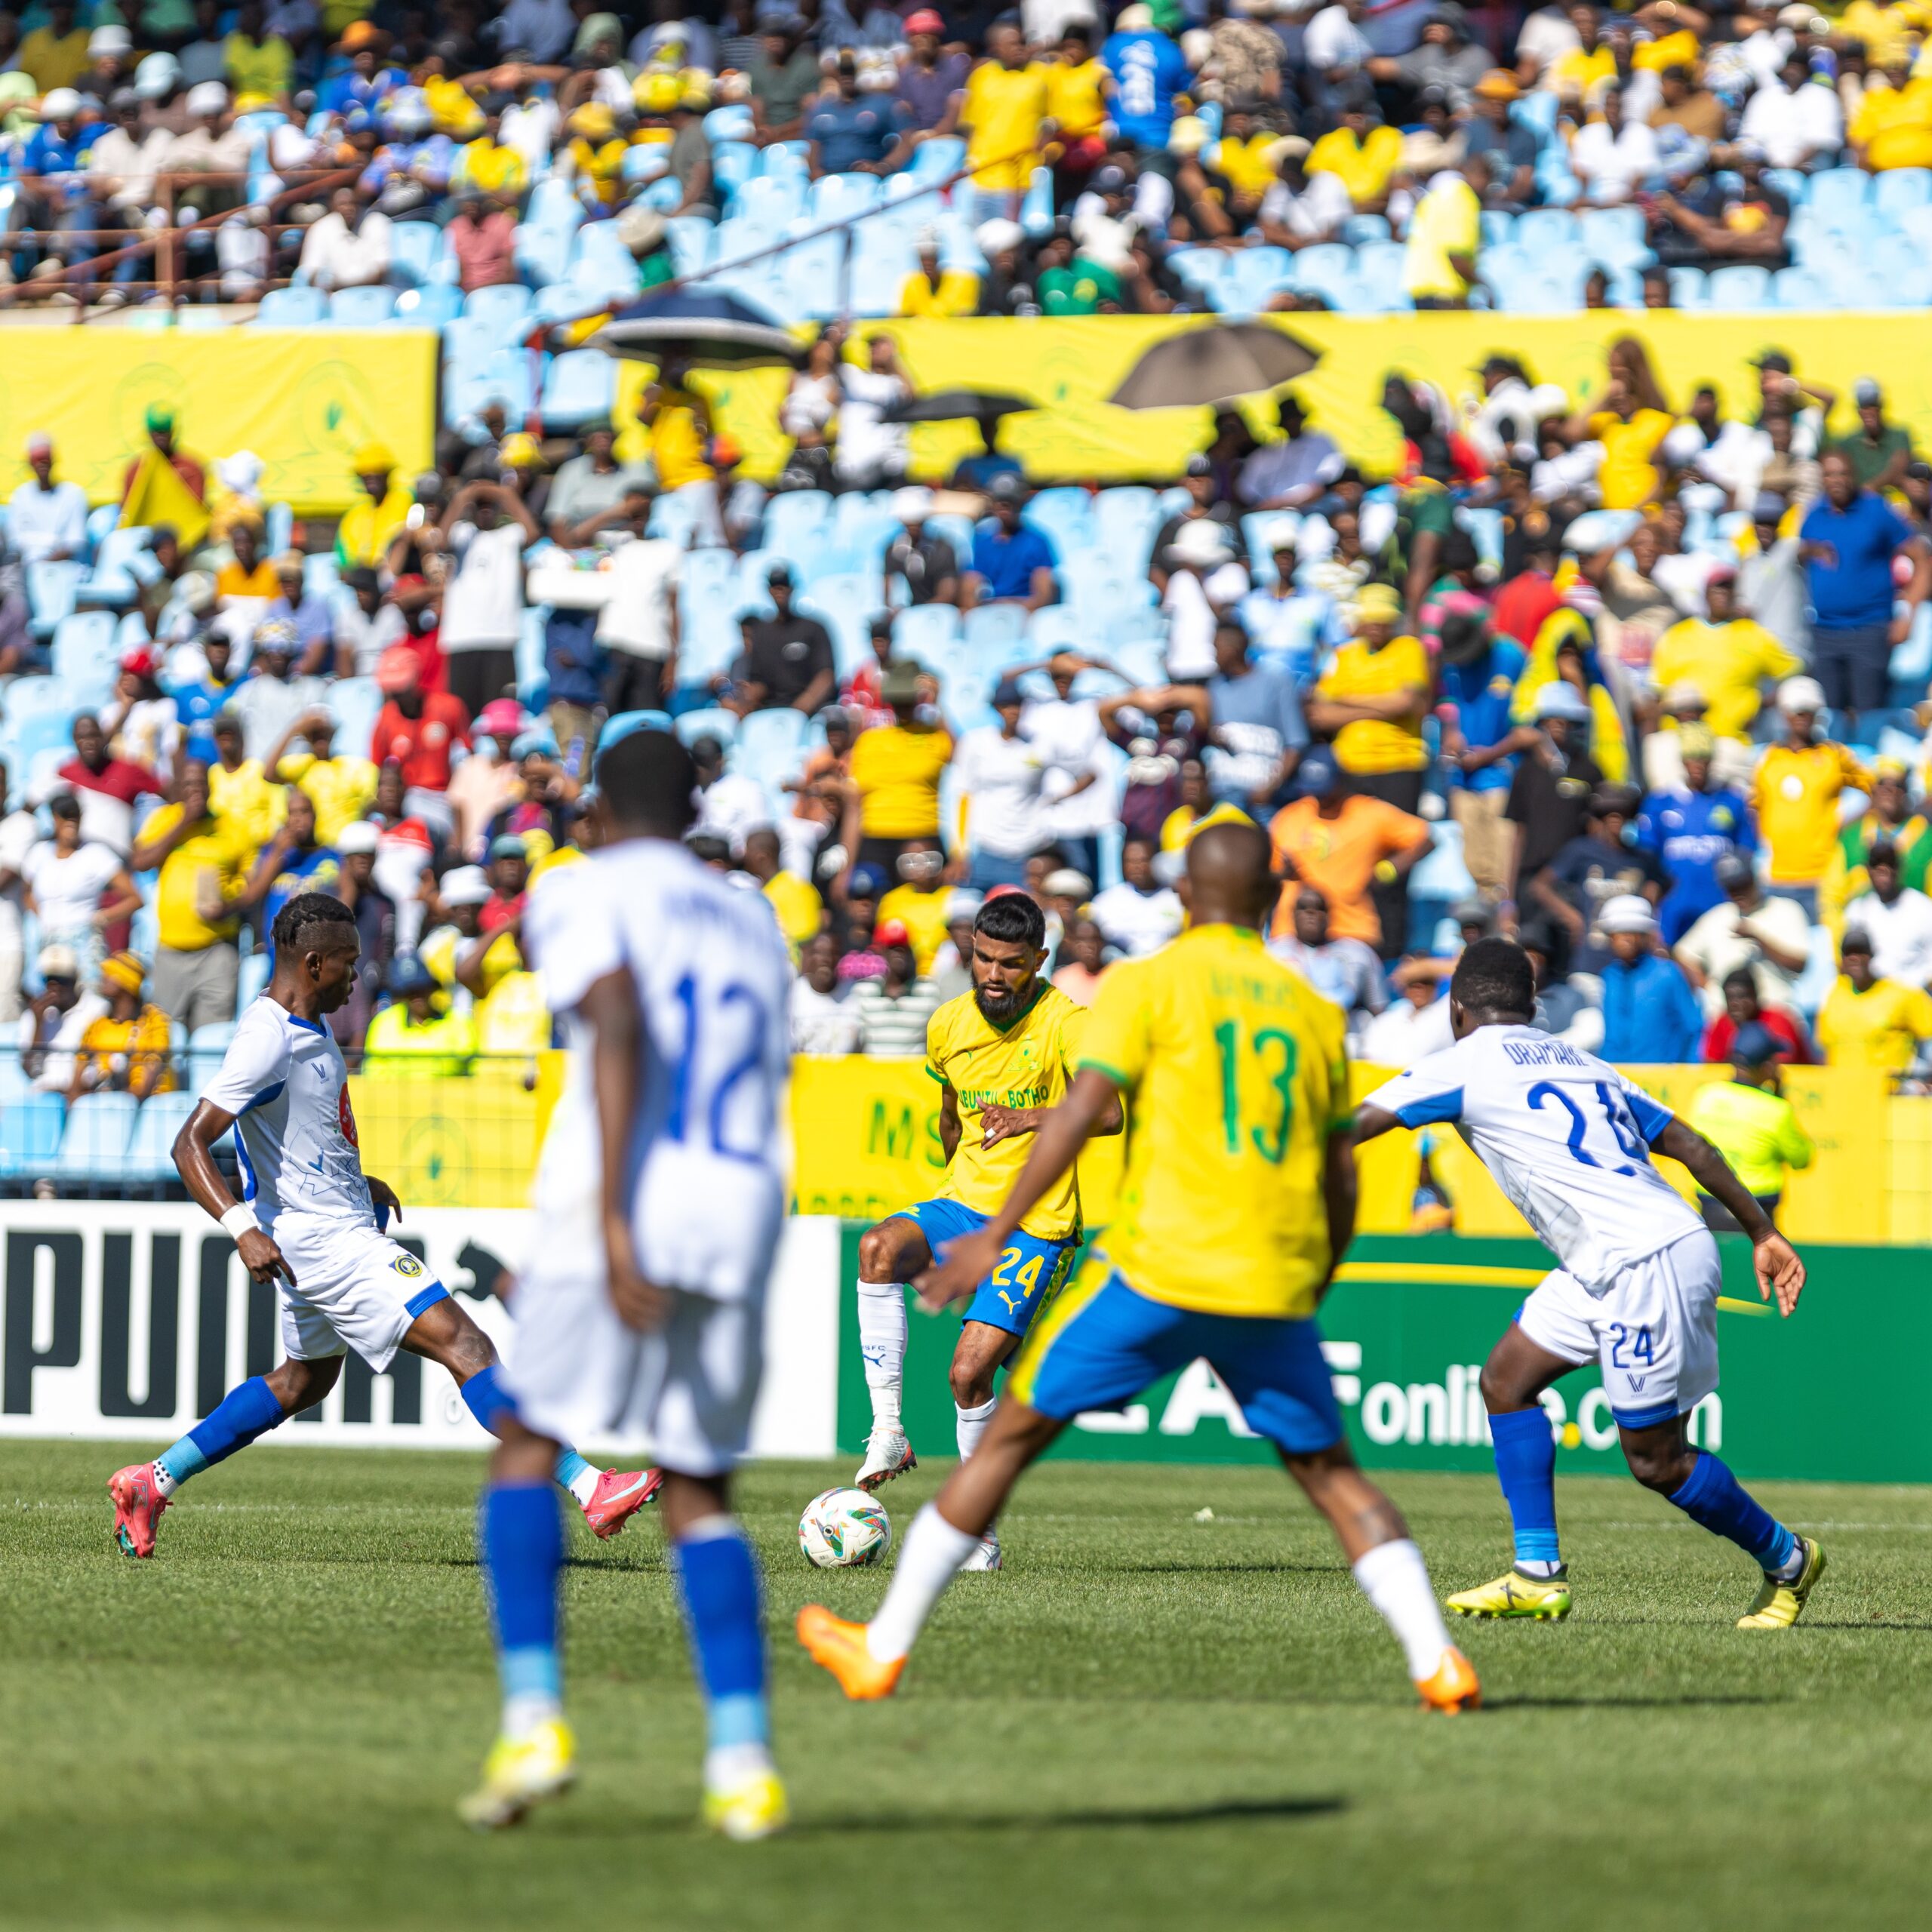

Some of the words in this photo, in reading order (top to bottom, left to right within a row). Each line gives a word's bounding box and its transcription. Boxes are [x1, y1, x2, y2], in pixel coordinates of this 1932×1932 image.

[667, 969, 768, 1164] 12
[1214, 1019, 1299, 1164] 13
[1008, 1085, 1049, 1109] BOTHO
[867, 1100, 946, 1168] MS
[992, 1247, 1046, 1298] 24
[1610, 1321, 1654, 1368] 24
